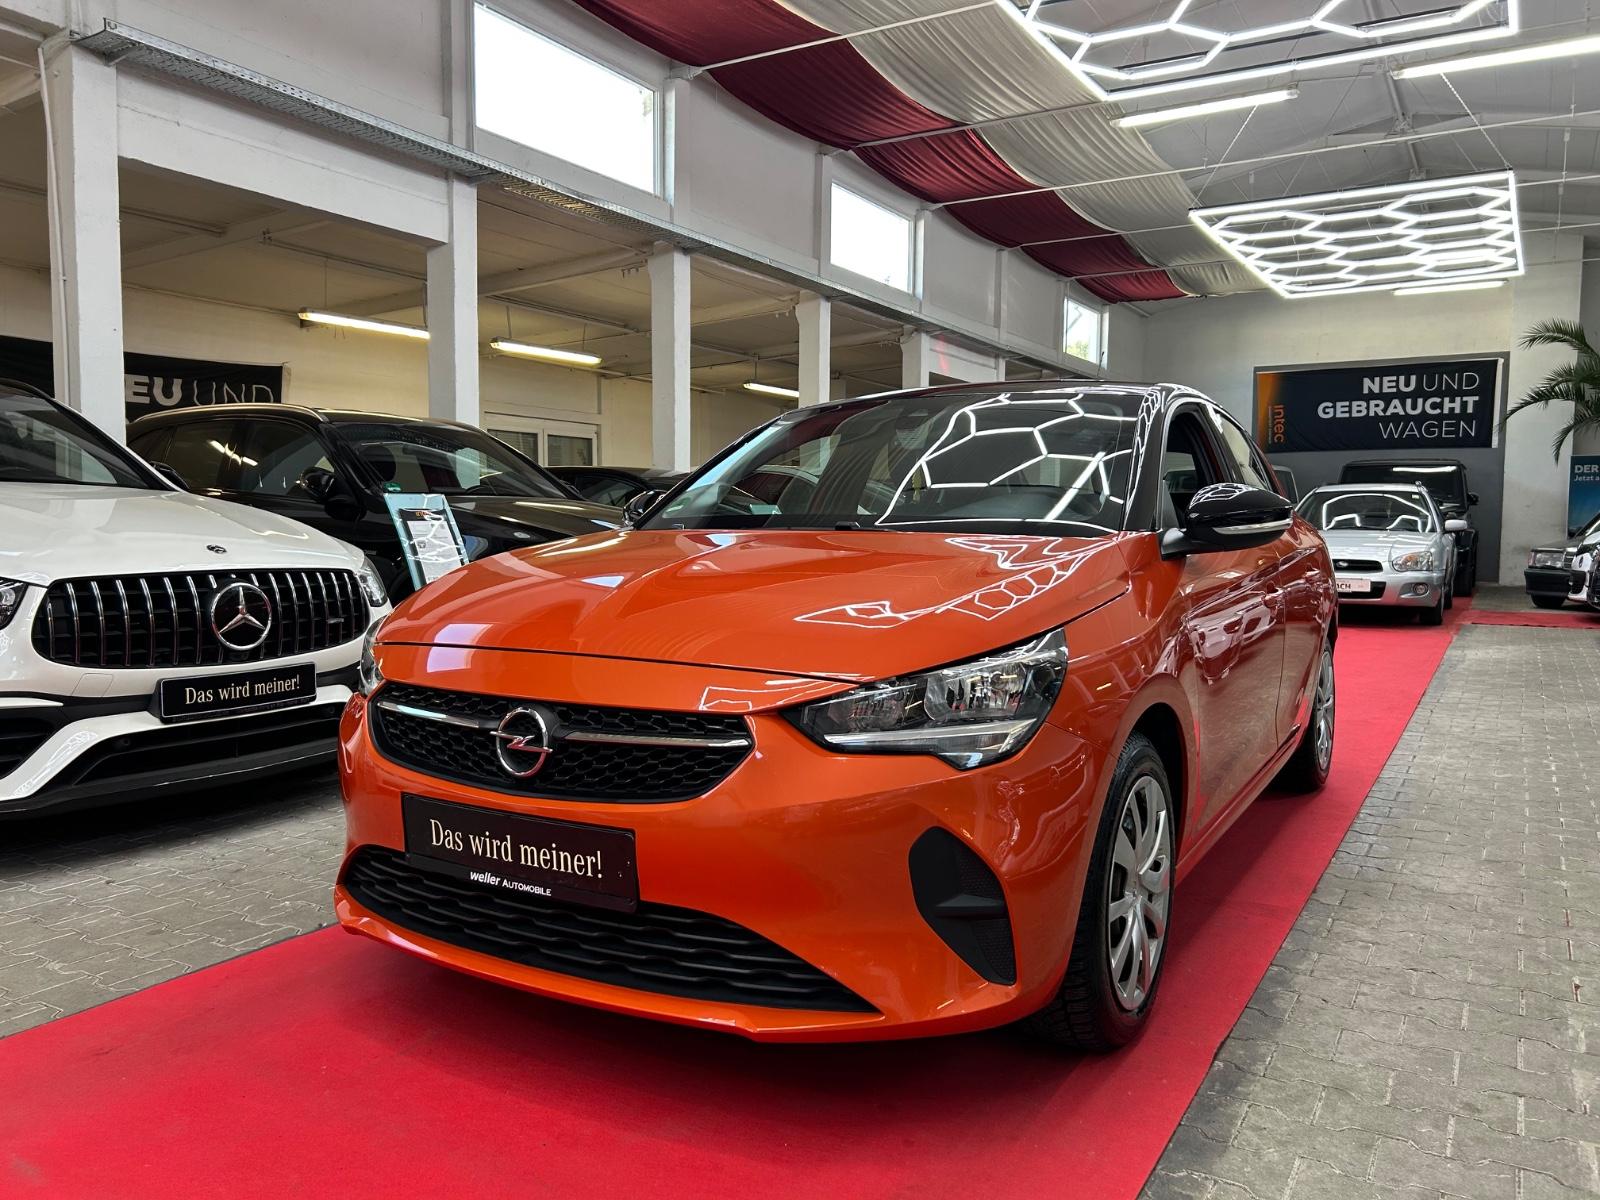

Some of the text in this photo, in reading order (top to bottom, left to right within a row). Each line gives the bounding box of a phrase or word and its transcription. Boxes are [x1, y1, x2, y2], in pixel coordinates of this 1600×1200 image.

[124, 373, 274, 406] EU UND
[1362, 372, 1480, 395] NEU UND
[1317, 396, 1480, 419] GEBRAUCHT
[1379, 420, 1476, 439] WAGEN
[1574, 464, 1599, 473] DER
[185, 674, 300, 704] Das wird meiner!
[430, 818, 602, 879] Das wird meiner!
[470, 871, 552, 897] weller AUTOMOBILE
